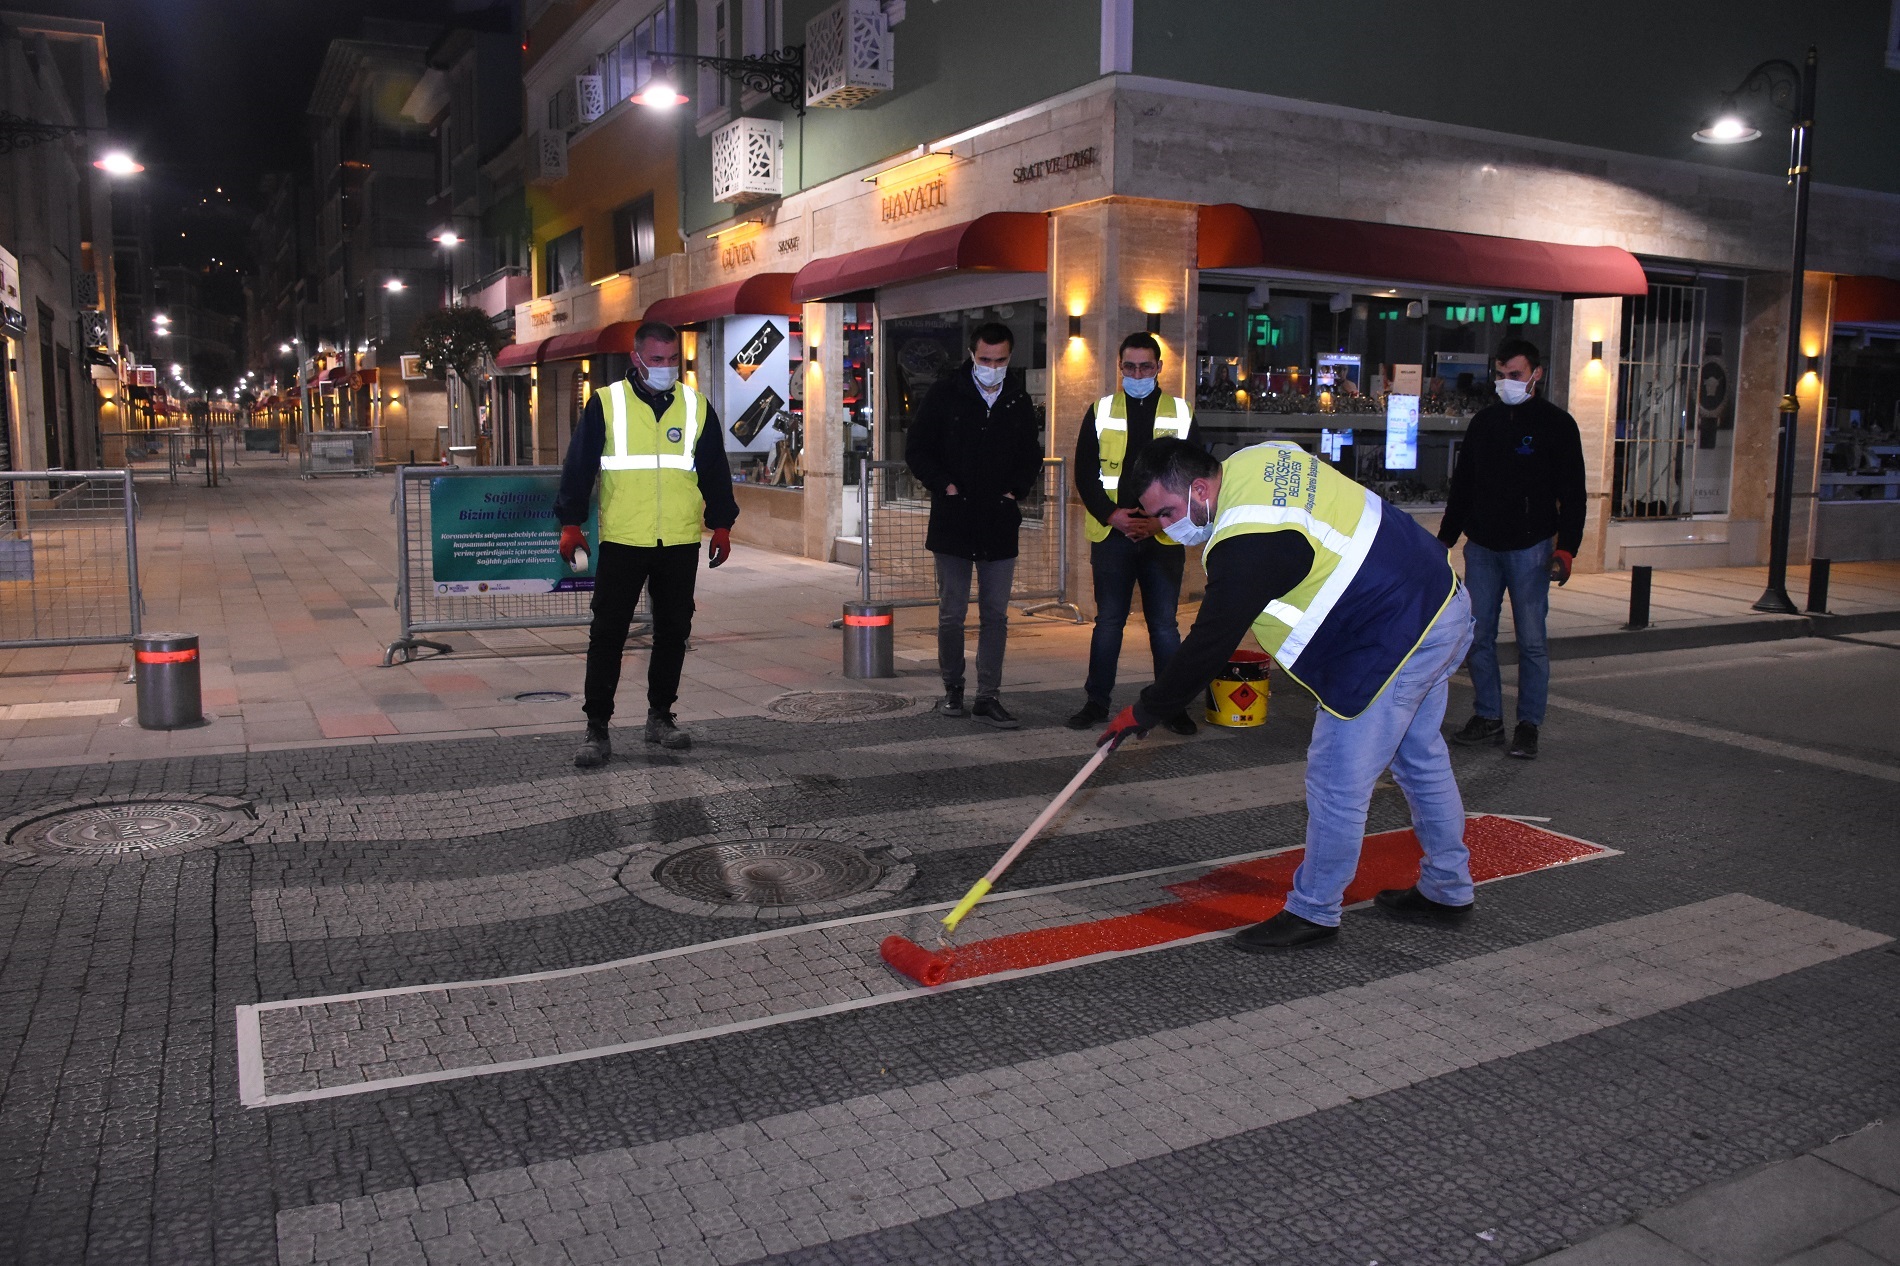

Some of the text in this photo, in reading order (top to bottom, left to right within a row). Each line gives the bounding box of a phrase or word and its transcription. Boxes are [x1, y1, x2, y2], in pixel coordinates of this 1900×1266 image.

[1013, 147, 1096, 184] SAAT VE TAKI
[722, 242, 757, 271] GÜVEN
[1263, 462, 1276, 483] ORDU
[484, 491, 547, 505] Sağlığınız
[459, 509, 494, 520] Bizim
[441, 532, 483, 540] Koronavirüs
[495, 540, 517, 548] sosyal
[453, 549, 475, 558] yerine
[515, 548, 527, 556] için
